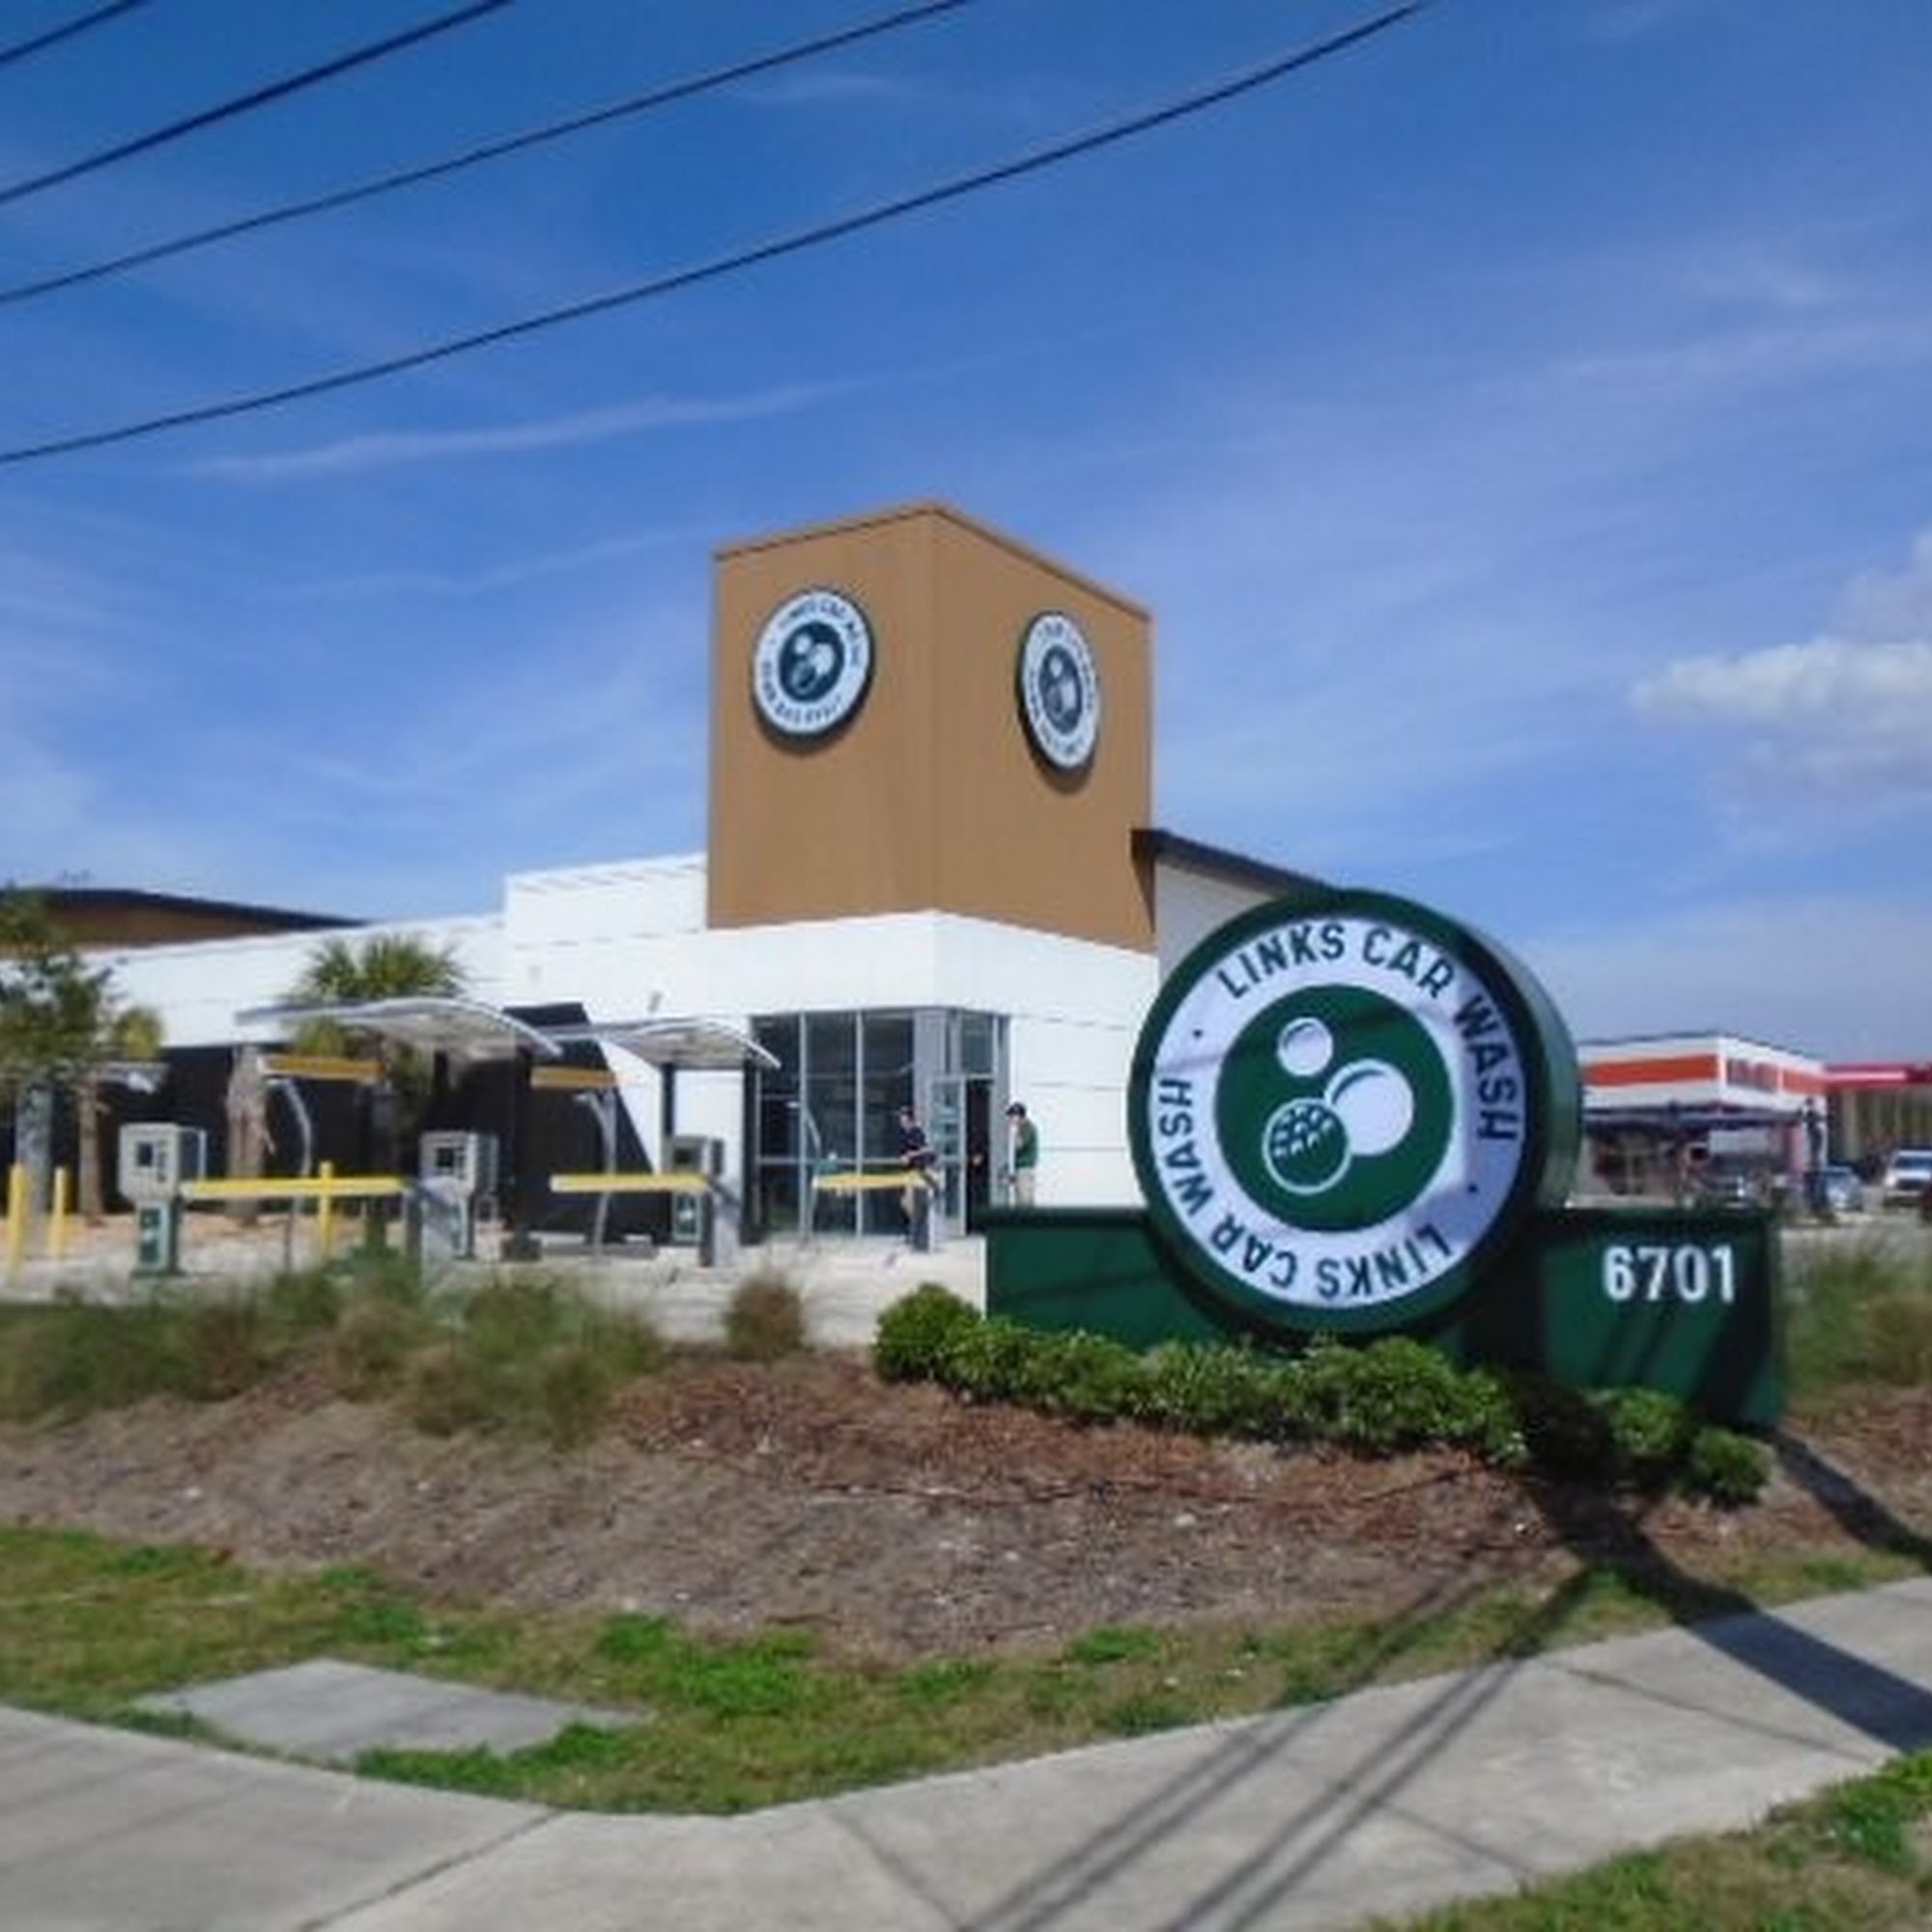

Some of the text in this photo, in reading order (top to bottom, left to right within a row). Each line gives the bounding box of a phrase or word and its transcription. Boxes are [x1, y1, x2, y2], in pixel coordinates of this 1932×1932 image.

[1217, 923, 1520, 1143] LINKS CAR WASH
[1159, 1079, 1453, 1299] LINKS CAR WASH
[1604, 1244, 1735, 1302] 6701
